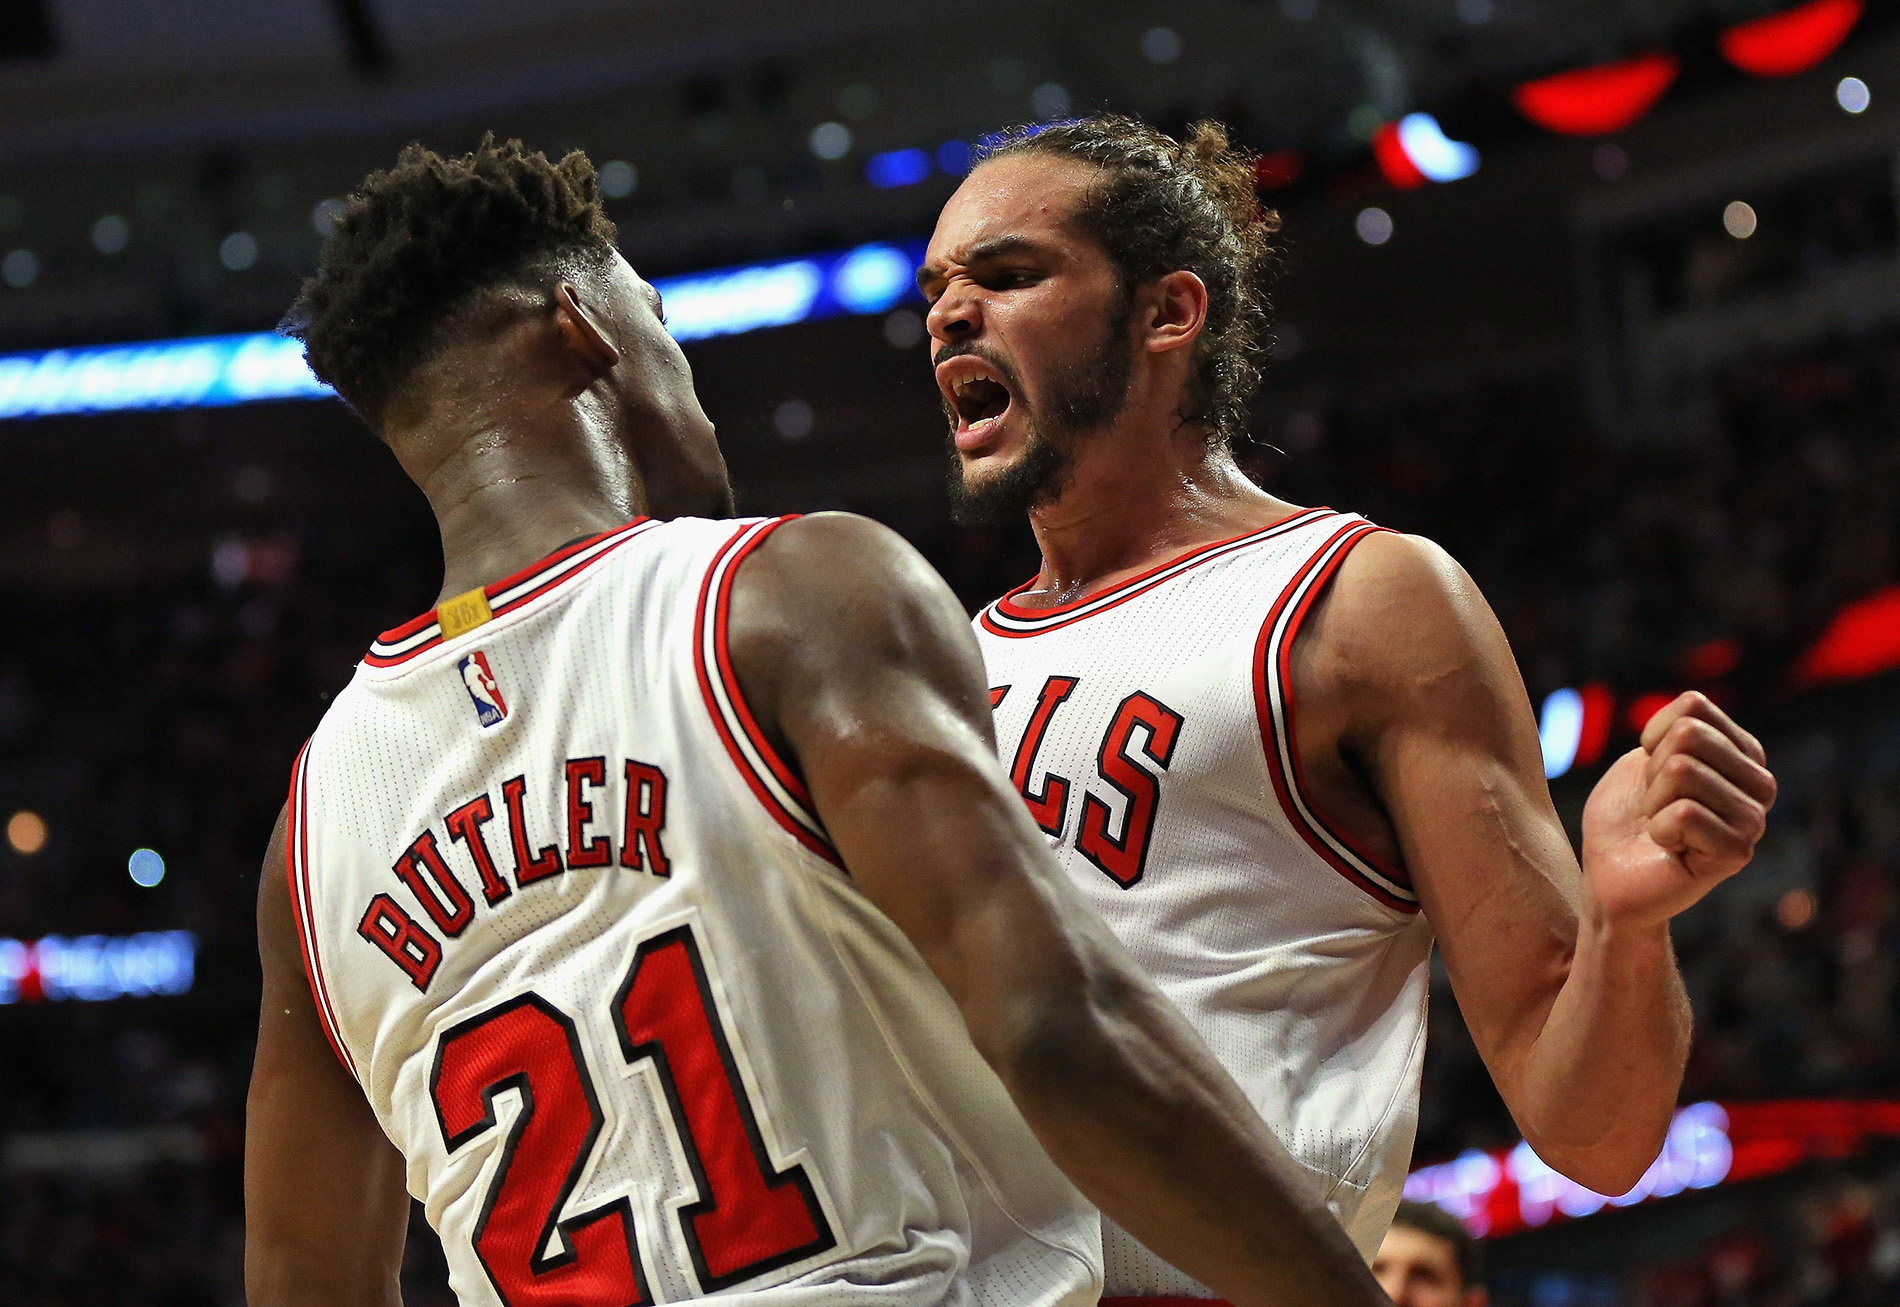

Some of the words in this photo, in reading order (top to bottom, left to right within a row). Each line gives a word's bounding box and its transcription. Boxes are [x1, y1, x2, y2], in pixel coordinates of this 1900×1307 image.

[480, 706, 501, 725] NBA
[989, 675, 1185, 890] LS
[357, 756, 671, 994] BUTLER
[430, 924, 837, 1307] 21
